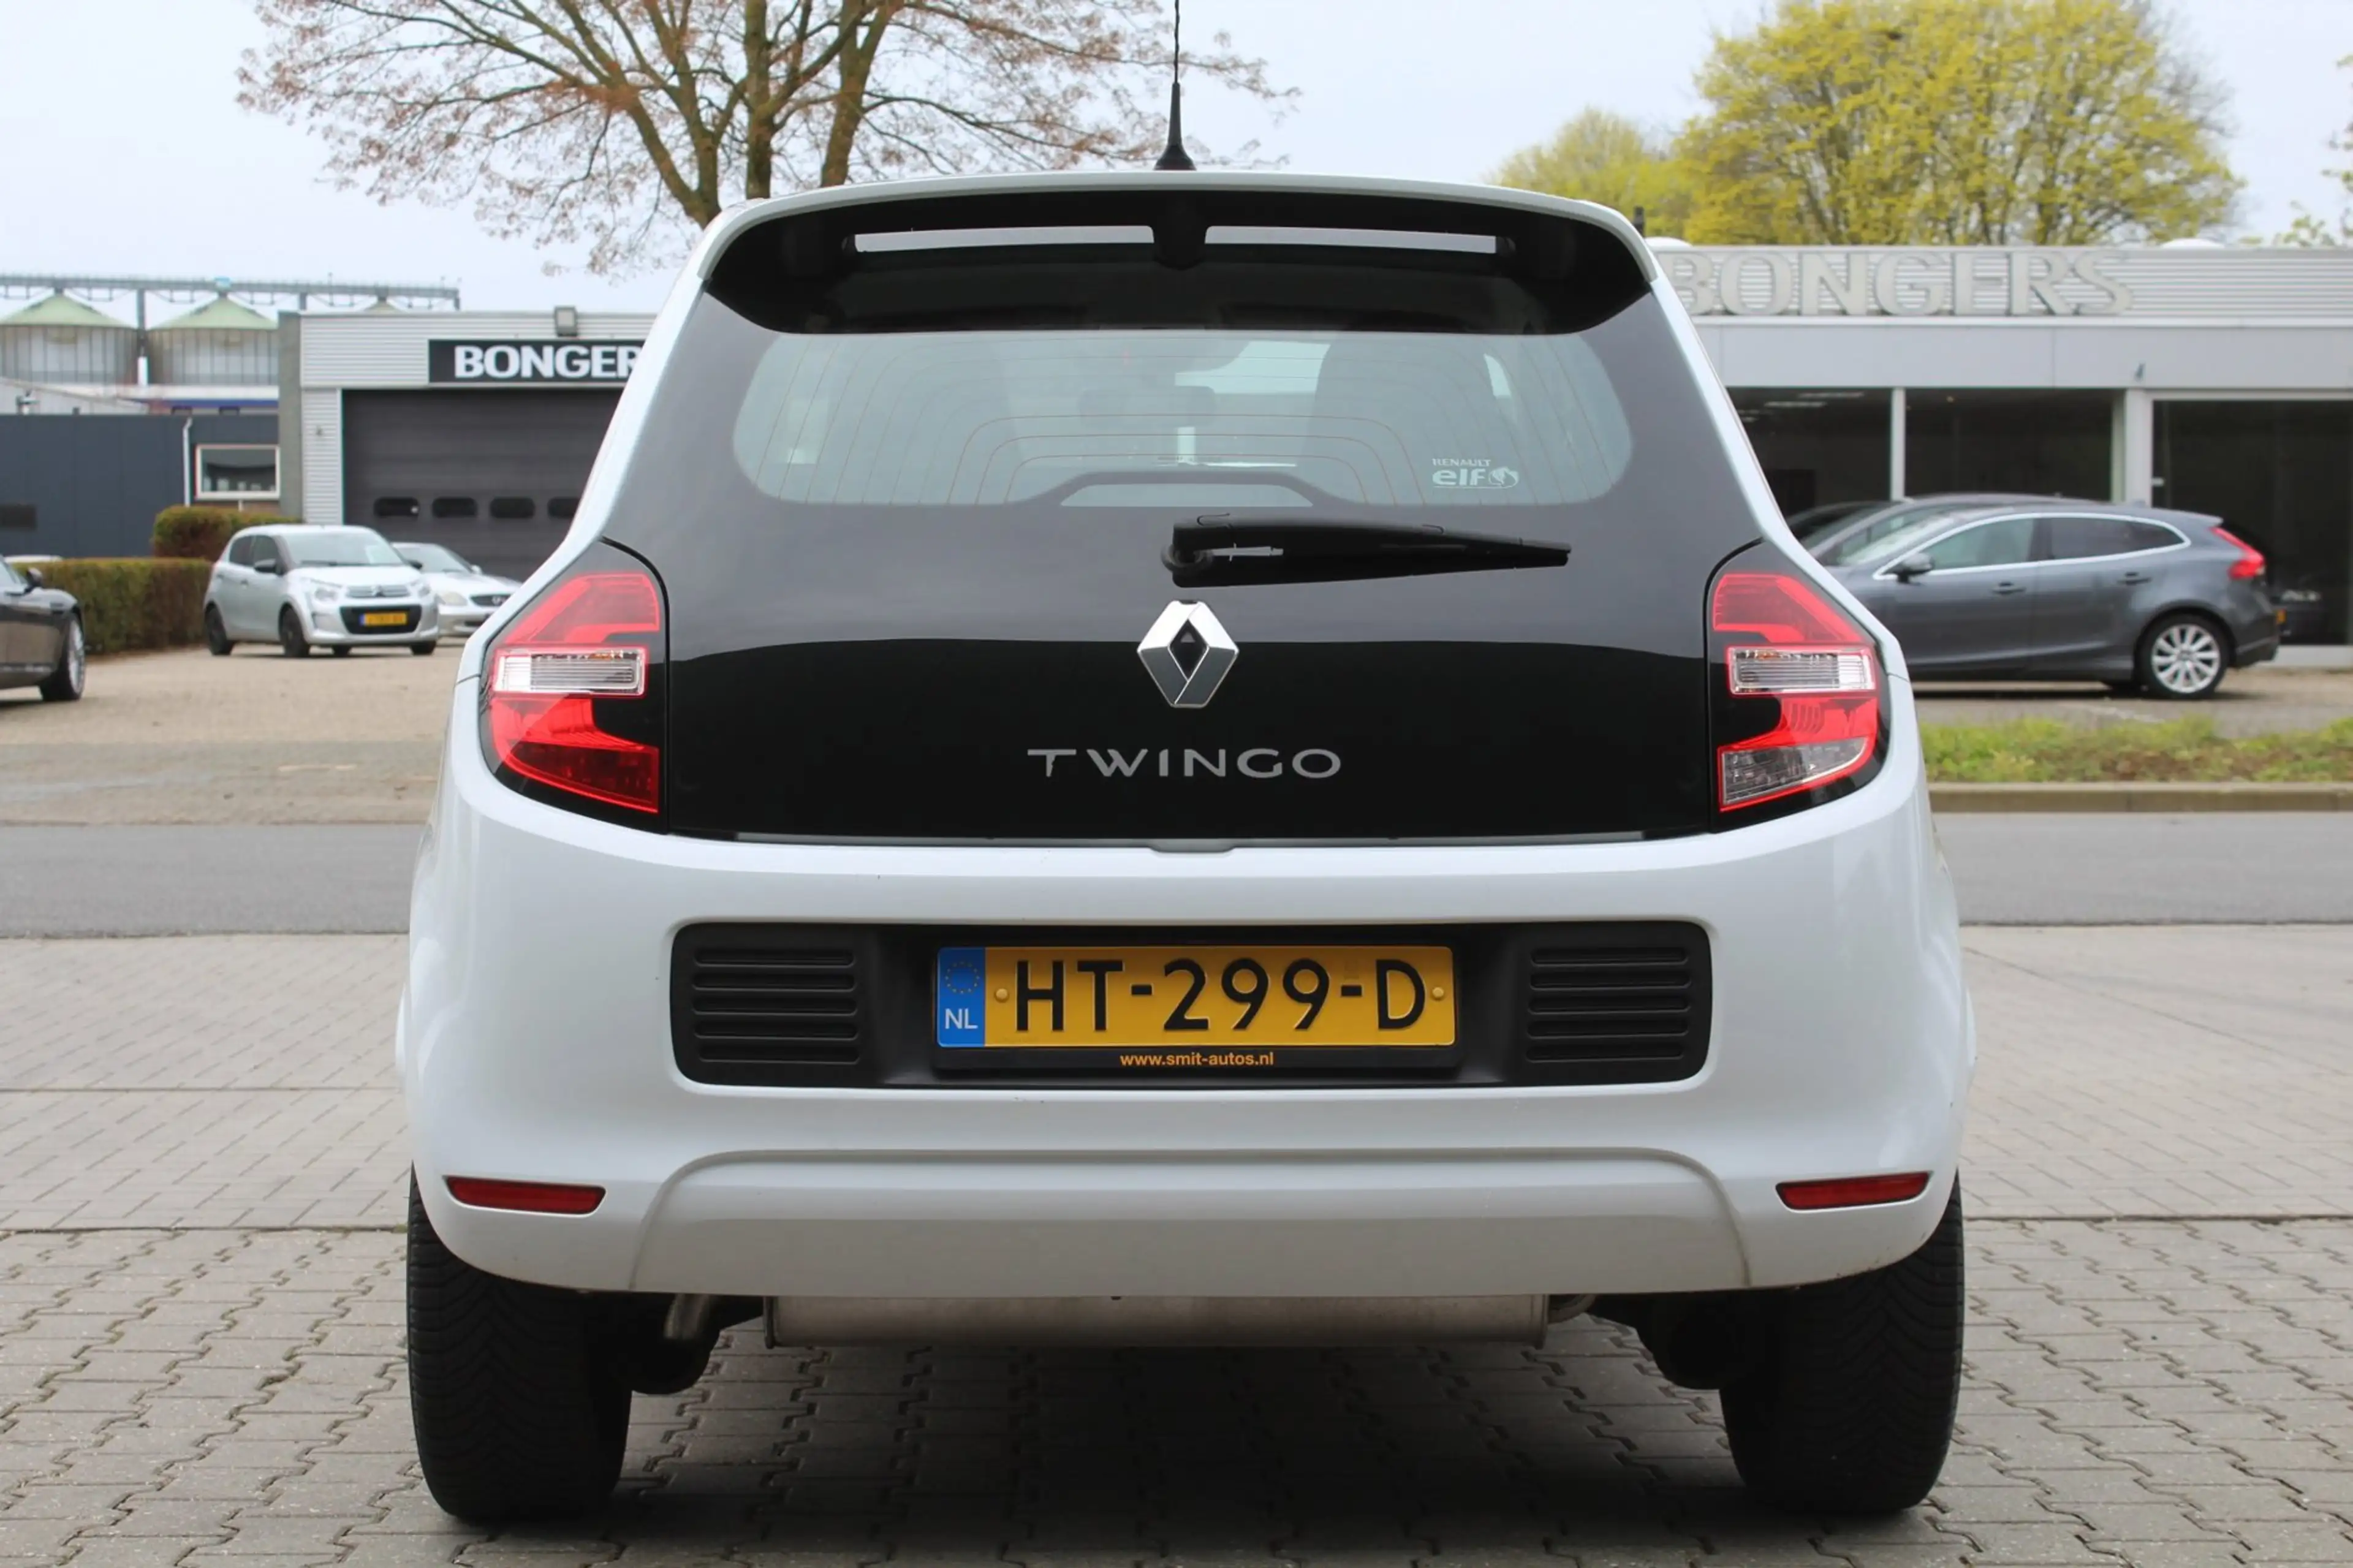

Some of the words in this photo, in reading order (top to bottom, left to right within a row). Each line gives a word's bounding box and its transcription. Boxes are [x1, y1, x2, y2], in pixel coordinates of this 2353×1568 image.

[1661, 251, 2131, 316] BONGERS
[1432, 458, 1491, 467] RENAULT
[1432, 468, 1486, 486] elf
[1027, 748, 1341, 779] TWINGO
[1015, 958, 1425, 1031] HT-299-D
[945, 1008, 979, 1030] NL
[1120, 1053, 1273, 1066] www.smit-autos.nl
